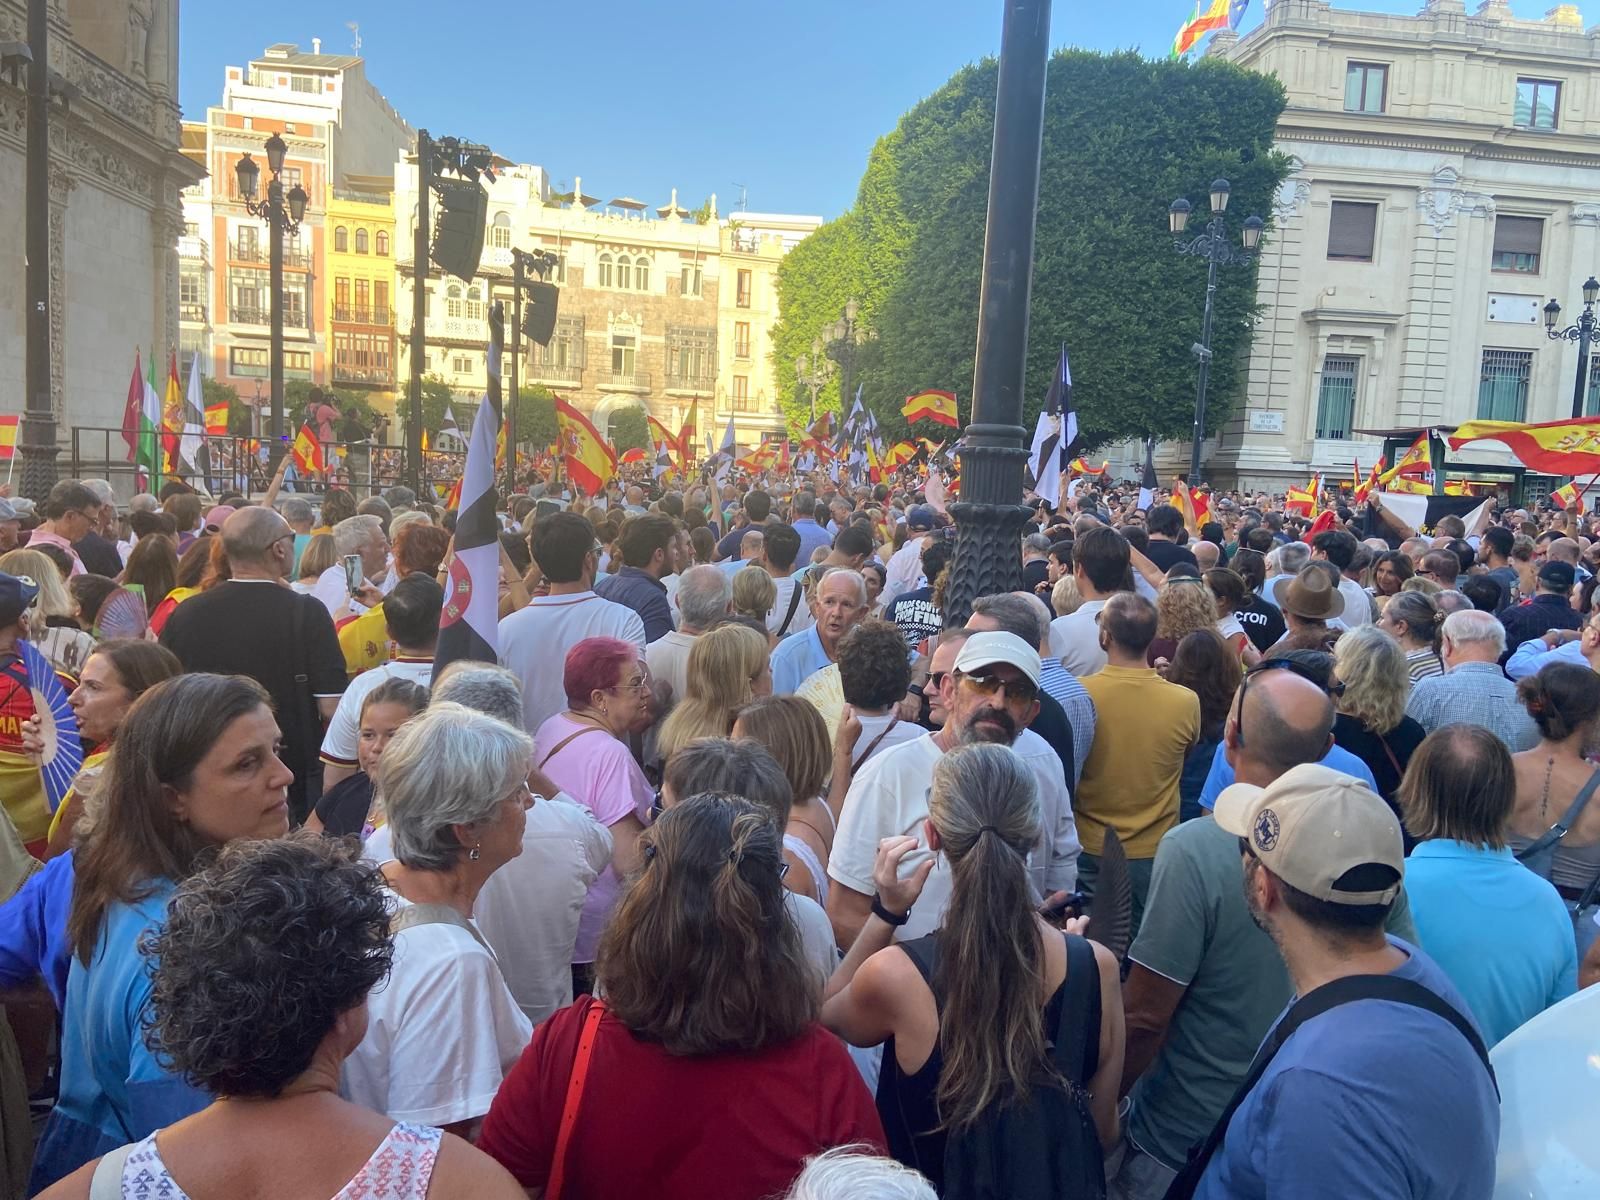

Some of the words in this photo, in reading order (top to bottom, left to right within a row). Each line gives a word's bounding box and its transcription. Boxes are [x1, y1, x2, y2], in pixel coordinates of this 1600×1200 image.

[895, 600, 915, 614] MADE
[915, 600, 940, 614] SOUT
[895, 607, 914, 623] FROM
[914, 611, 943, 626] FIN
